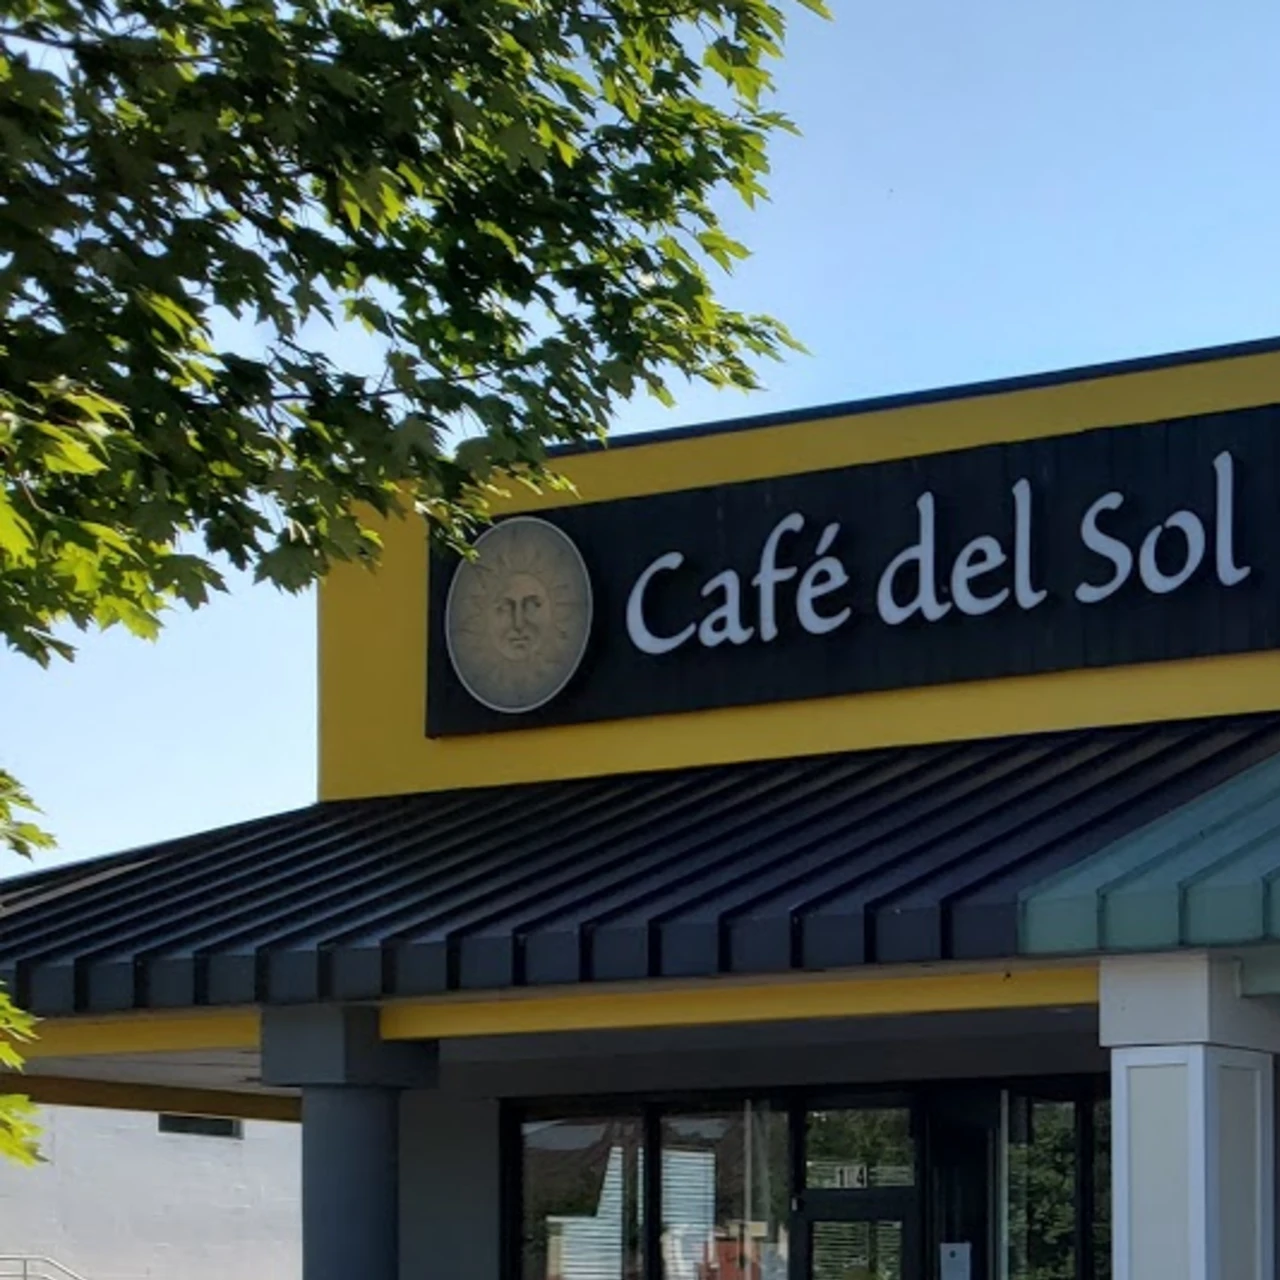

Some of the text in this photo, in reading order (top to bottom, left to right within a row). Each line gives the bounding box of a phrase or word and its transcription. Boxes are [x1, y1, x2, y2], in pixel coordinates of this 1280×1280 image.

[625, 450, 1252, 655] Café del Sol
